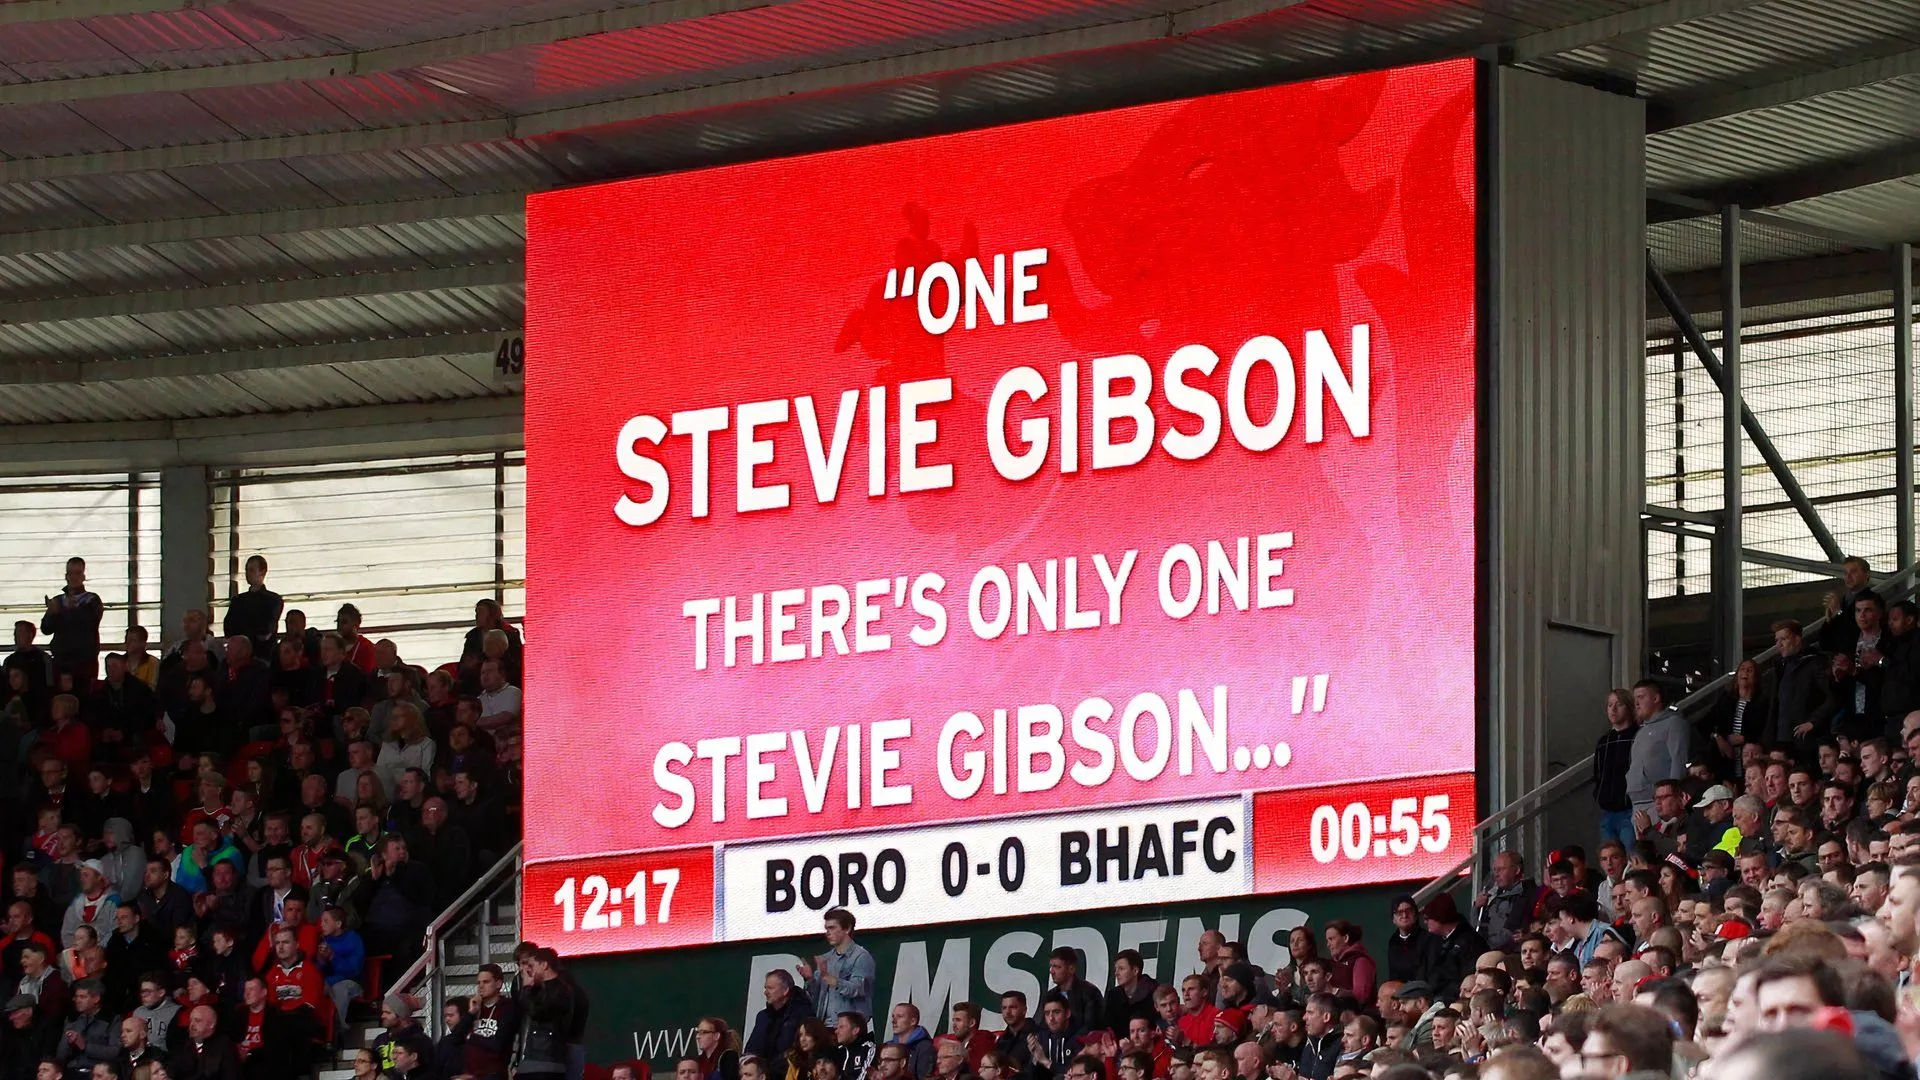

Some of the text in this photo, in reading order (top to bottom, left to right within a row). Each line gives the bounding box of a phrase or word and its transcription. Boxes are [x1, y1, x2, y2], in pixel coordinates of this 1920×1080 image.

[496, 337, 525, 374] 49
[613, 324, 1370, 526] STEVIE GIBSON
[682, 531, 1294, 671] THERE'S ONLY ONE
[651, 717, 912, 828] STEVIE
[765, 816, 1236, 914] BORO 0-0 BHAFC
[1310, 794, 1452, 864] 00:55
[553, 868, 680, 932] 12:17
[741, 907, 1310, 1055] MSDENS
